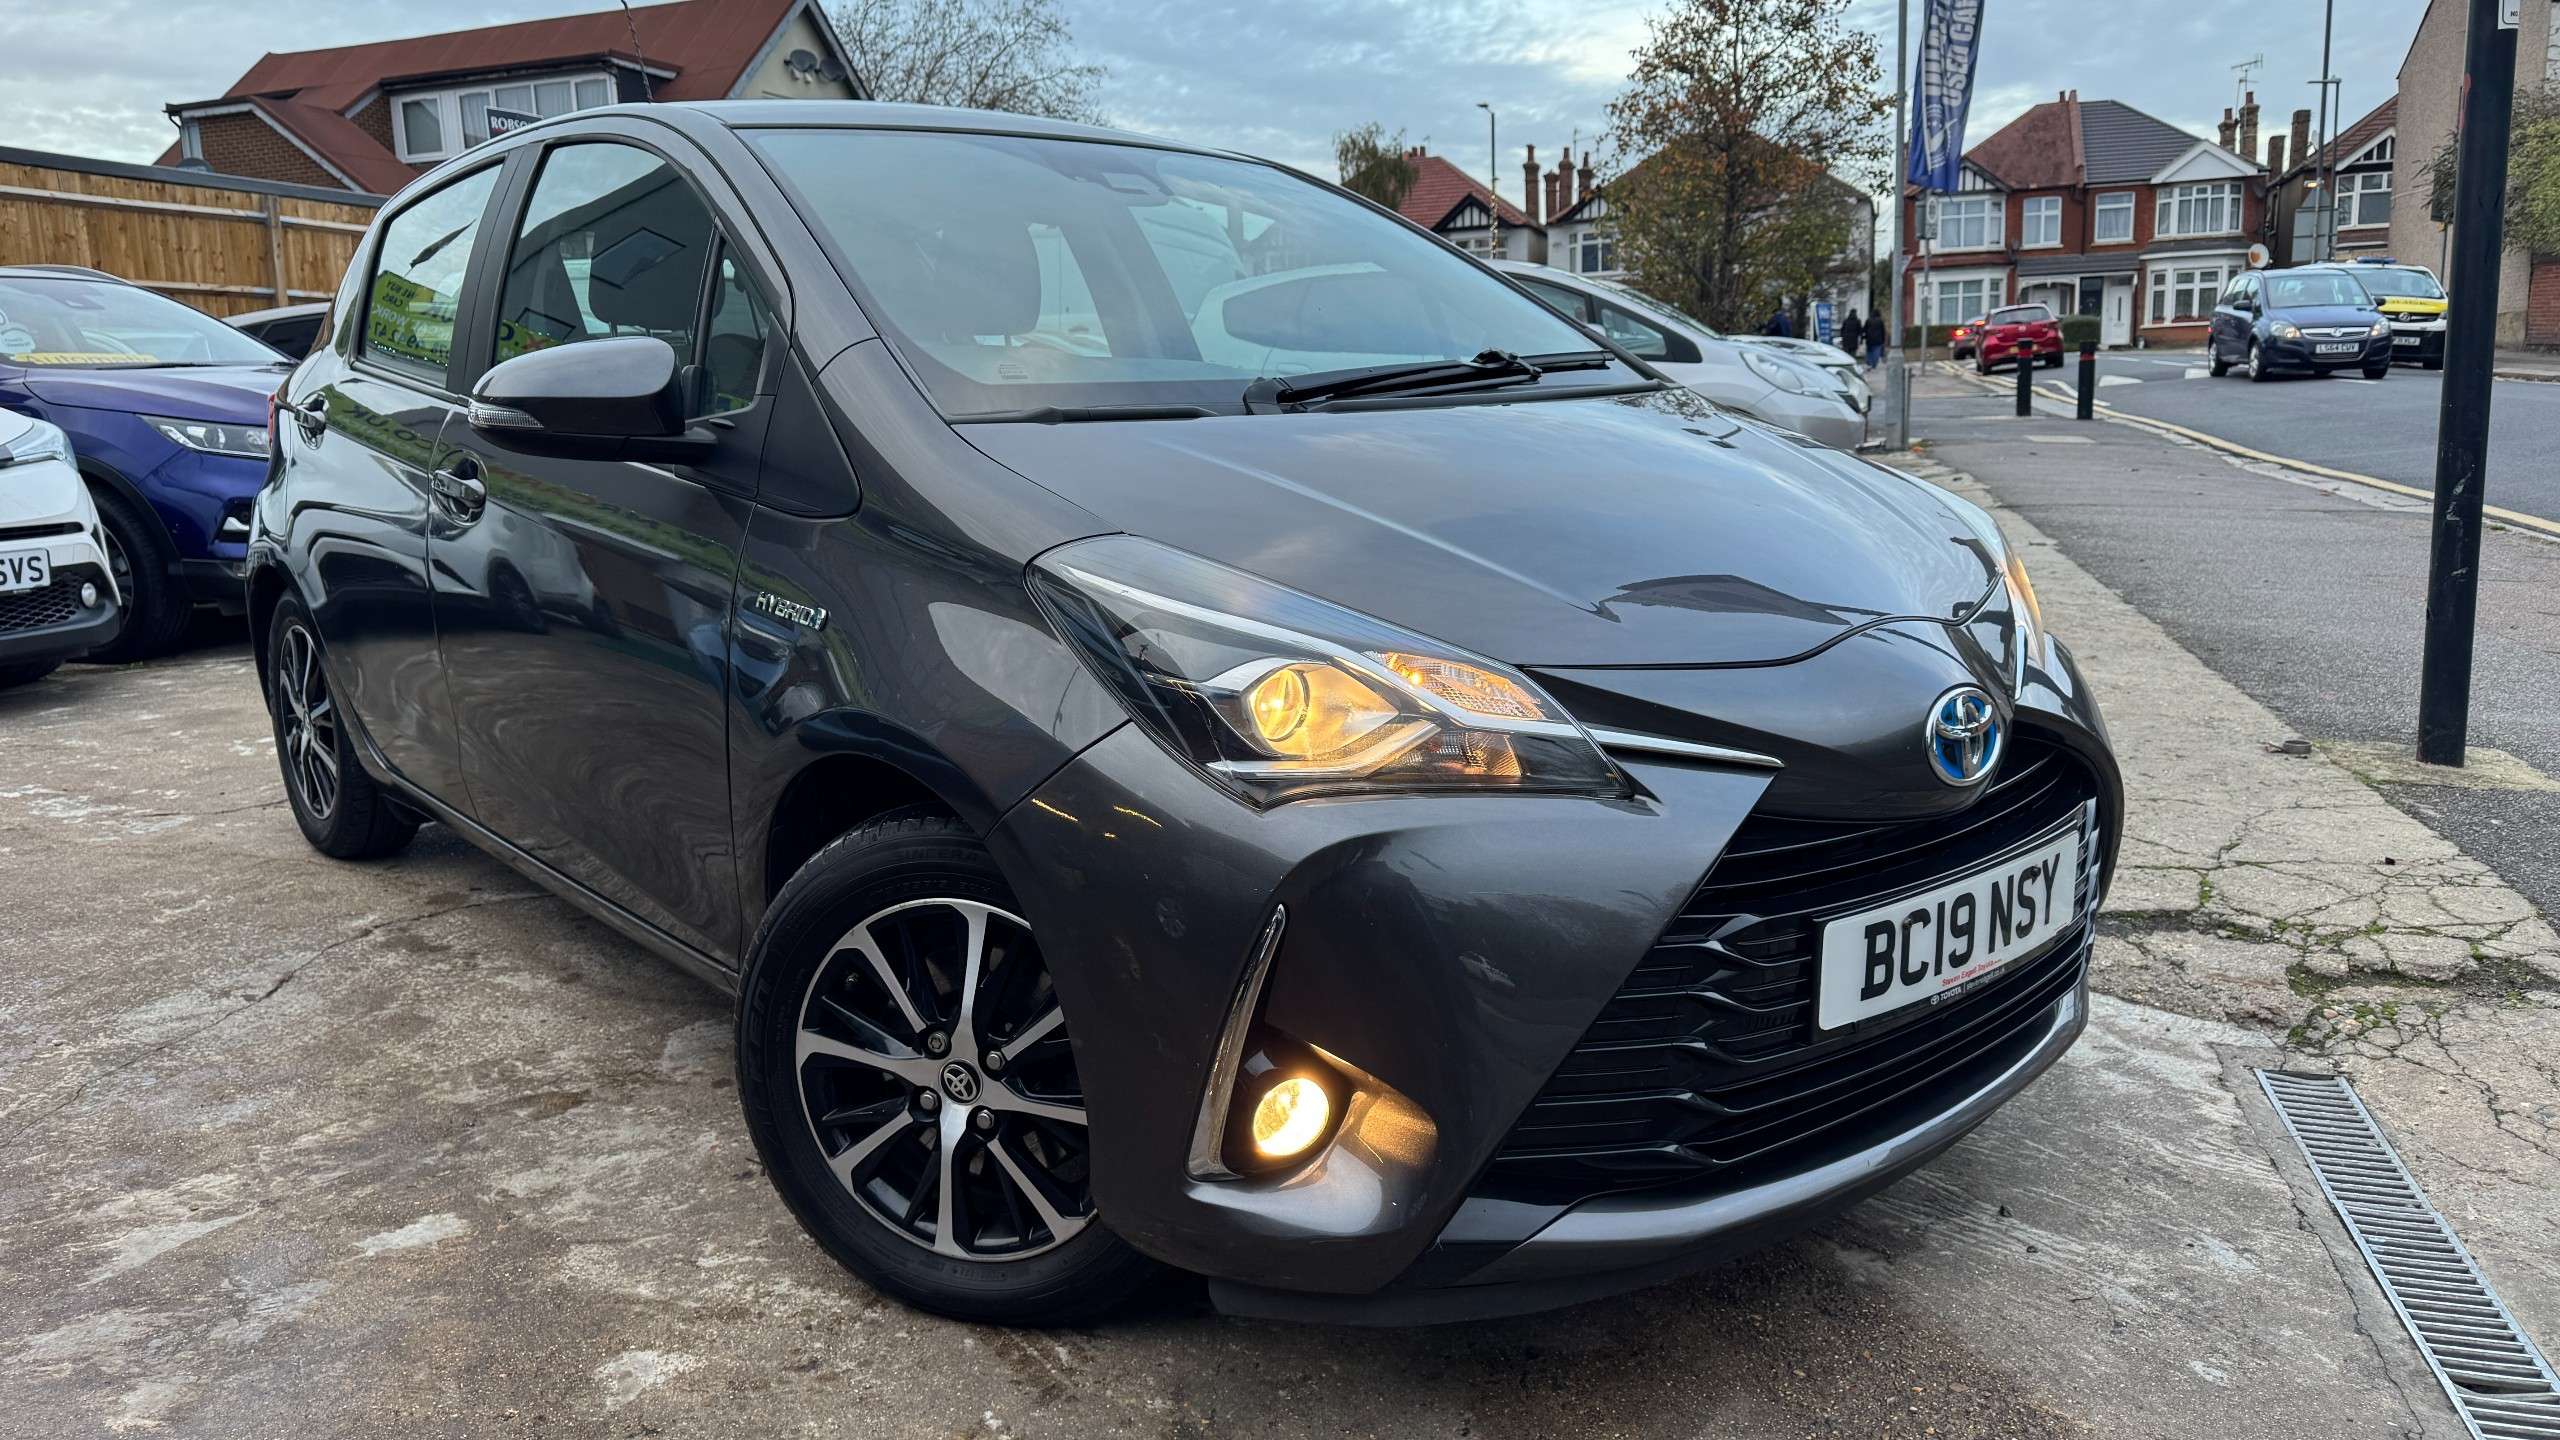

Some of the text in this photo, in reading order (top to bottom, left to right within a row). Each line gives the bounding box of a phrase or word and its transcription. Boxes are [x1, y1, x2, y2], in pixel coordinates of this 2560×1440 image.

[1942, 44, 1969, 107] USED
[490, 116, 529, 131] ROBSO
[756, 591, 814, 625] HYBRID
[1860, 852, 2061, 1001] BC19 NSY
[1940, 986, 1962, 1001] TOYOTA
